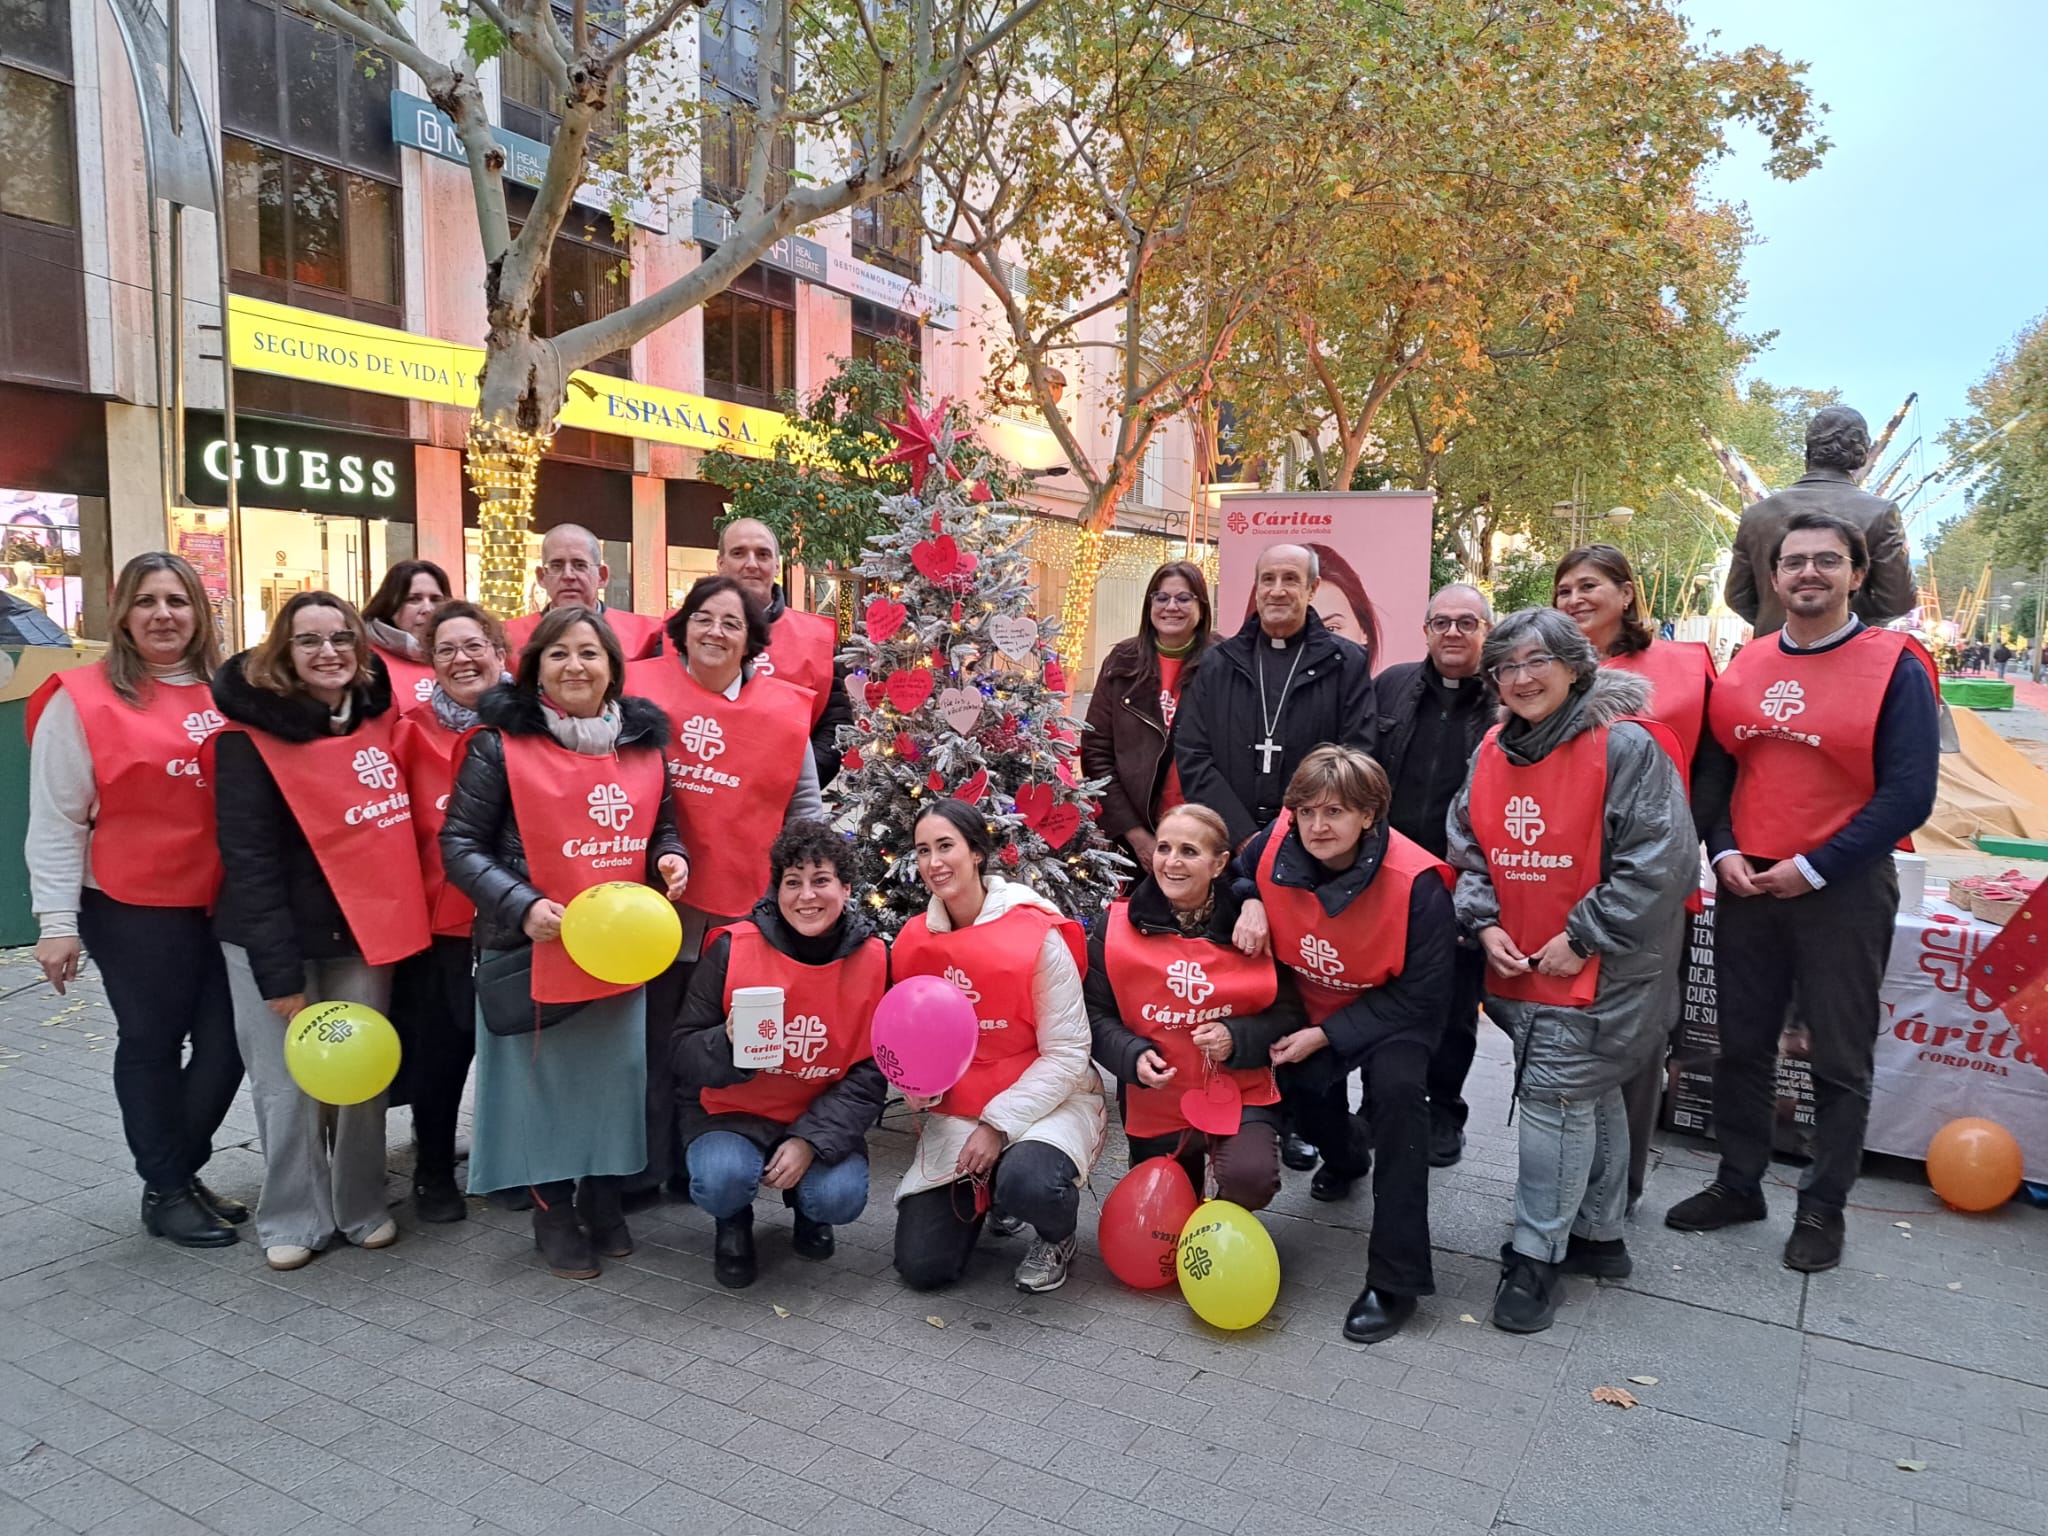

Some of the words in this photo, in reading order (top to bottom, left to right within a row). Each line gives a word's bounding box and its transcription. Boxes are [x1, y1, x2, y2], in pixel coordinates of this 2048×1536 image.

[517, 151, 541, 169] REAL
[517, 164, 546, 183] ESTAT
[795, 244, 813, 260] REAL
[795, 256, 821, 274] ESTATE
[833, 258, 886, 286] GESTIONAMOS
[253, 331, 359, 369] SEGUROS
[367, 354, 394, 376] DE
[400, 360, 449, 386] VIDA
[456, 371, 466, 388] Y
[203, 440, 396, 498] GUESS
[1252, 510, 1332, 526] Cáritas
[1734, 724, 1822, 747] Cáitas
[668, 758, 741, 788] áritas
[562, 835, 648, 858] Cáritas
[1491, 847, 1573, 868] Cáritas
[591, 857, 633, 869] Córdoba
[1505, 870, 1546, 882] Córdoba
[1692, 926, 1714, 946] TEN
[1690, 946, 1714, 966] VID
[1686, 984, 1718, 1006] CUES
[1141, 1003, 1233, 1025] Cáritas
[1684, 1003, 1700, 1022] DE
[1701, 1006, 1718, 1025] SU
[1918, 1050, 2009, 1077] CORDOBA
[1178, 1221, 1222, 1250] Cárita
